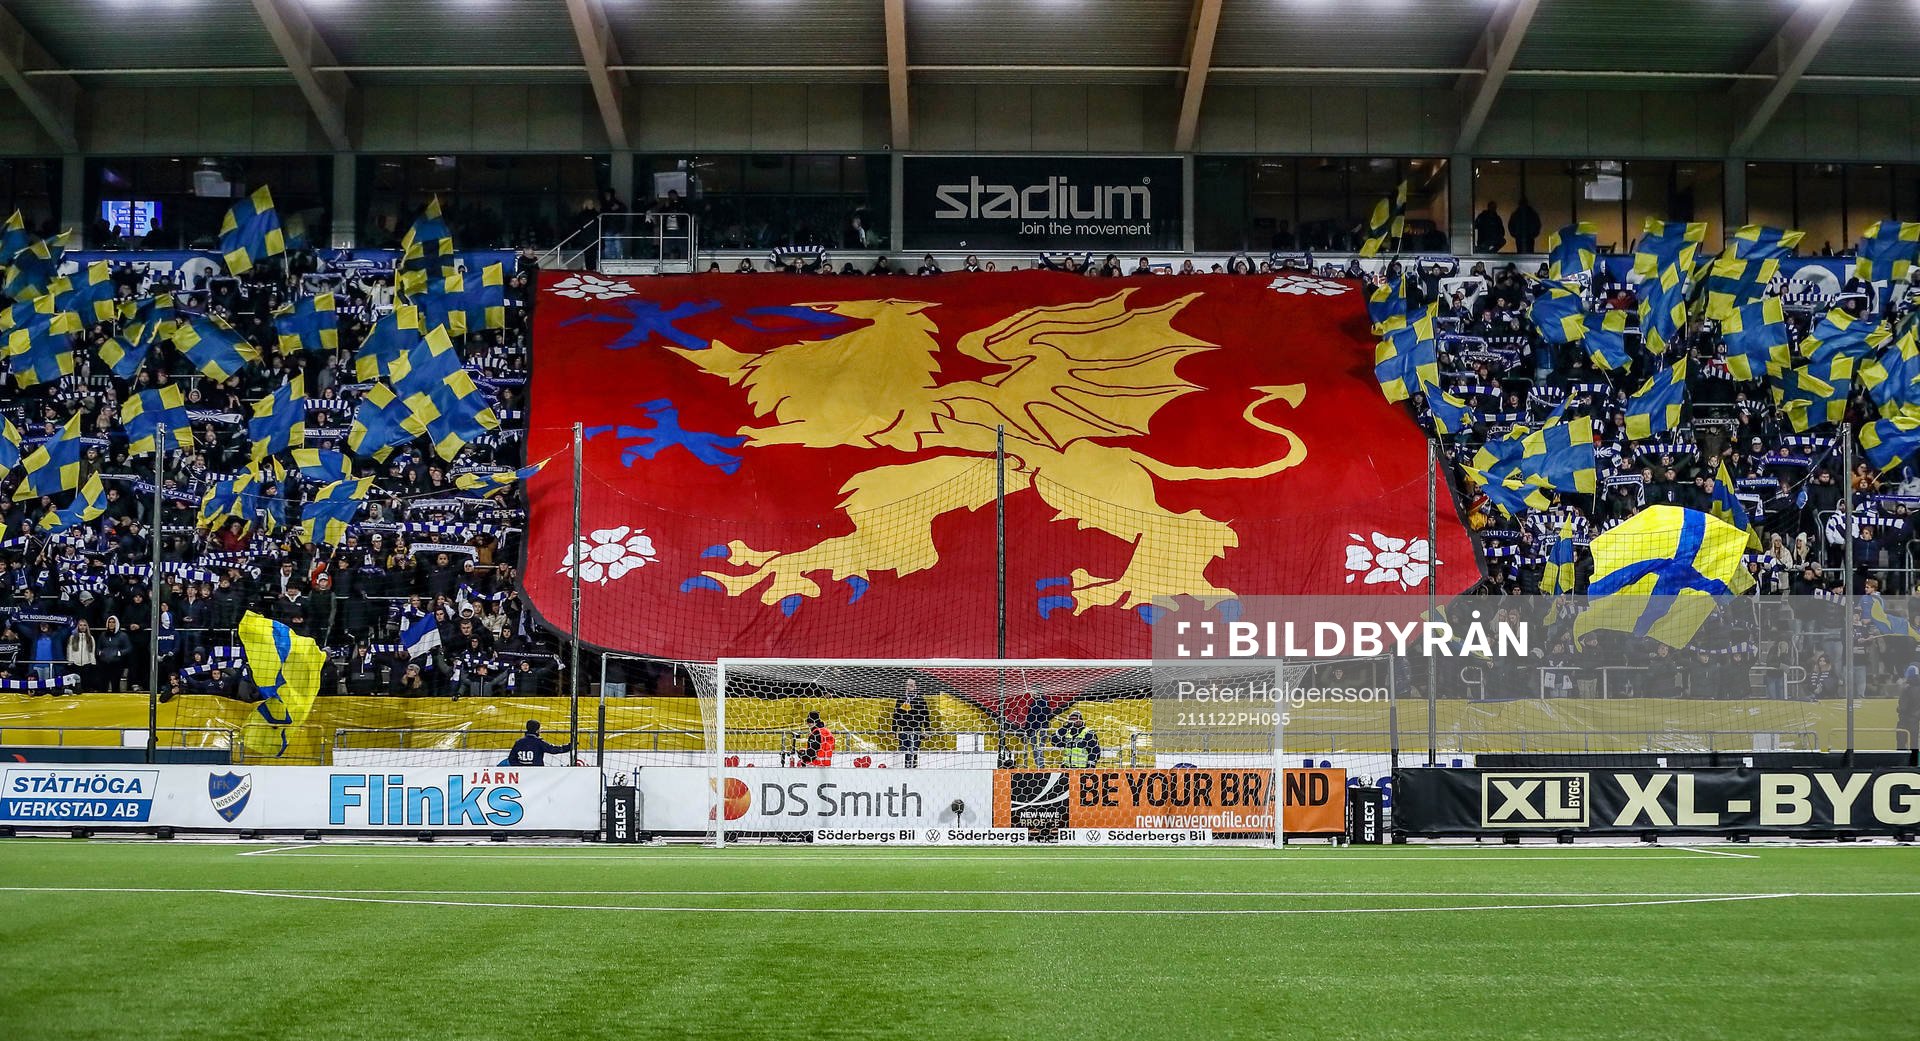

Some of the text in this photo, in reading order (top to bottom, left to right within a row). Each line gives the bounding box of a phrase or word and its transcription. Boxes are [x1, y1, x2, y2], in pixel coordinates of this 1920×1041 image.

[935, 175, 1150, 219] stadium
[1019, 221, 1151, 235] Join the movement
[517, 751, 534, 761] SLO
[12, 772, 143, 794] STÅTHÖGA
[212, 780, 230, 790] IFK
[470, 768, 520, 785] JÄRN
[1079, 772, 1119, 807] BE
[1125, 772, 1213, 807] YOUR
[329, 774, 524, 826] Flinks
[761, 782, 922, 817] DS Smith
[1489, 780, 1580, 820] XL
[9, 801, 140, 818] VERKSTAD AB
[1020, 811, 1060, 819] NEW WAVE
[615, 798, 626, 839] SELECT
[1364, 801, 1375, 842] SELECT
[817, 829, 915, 842] Söderbergs Bil
[947, 829, 1076, 843] Söderbergs Bil
[1107, 830, 1206, 843] Söderbergs Bil
